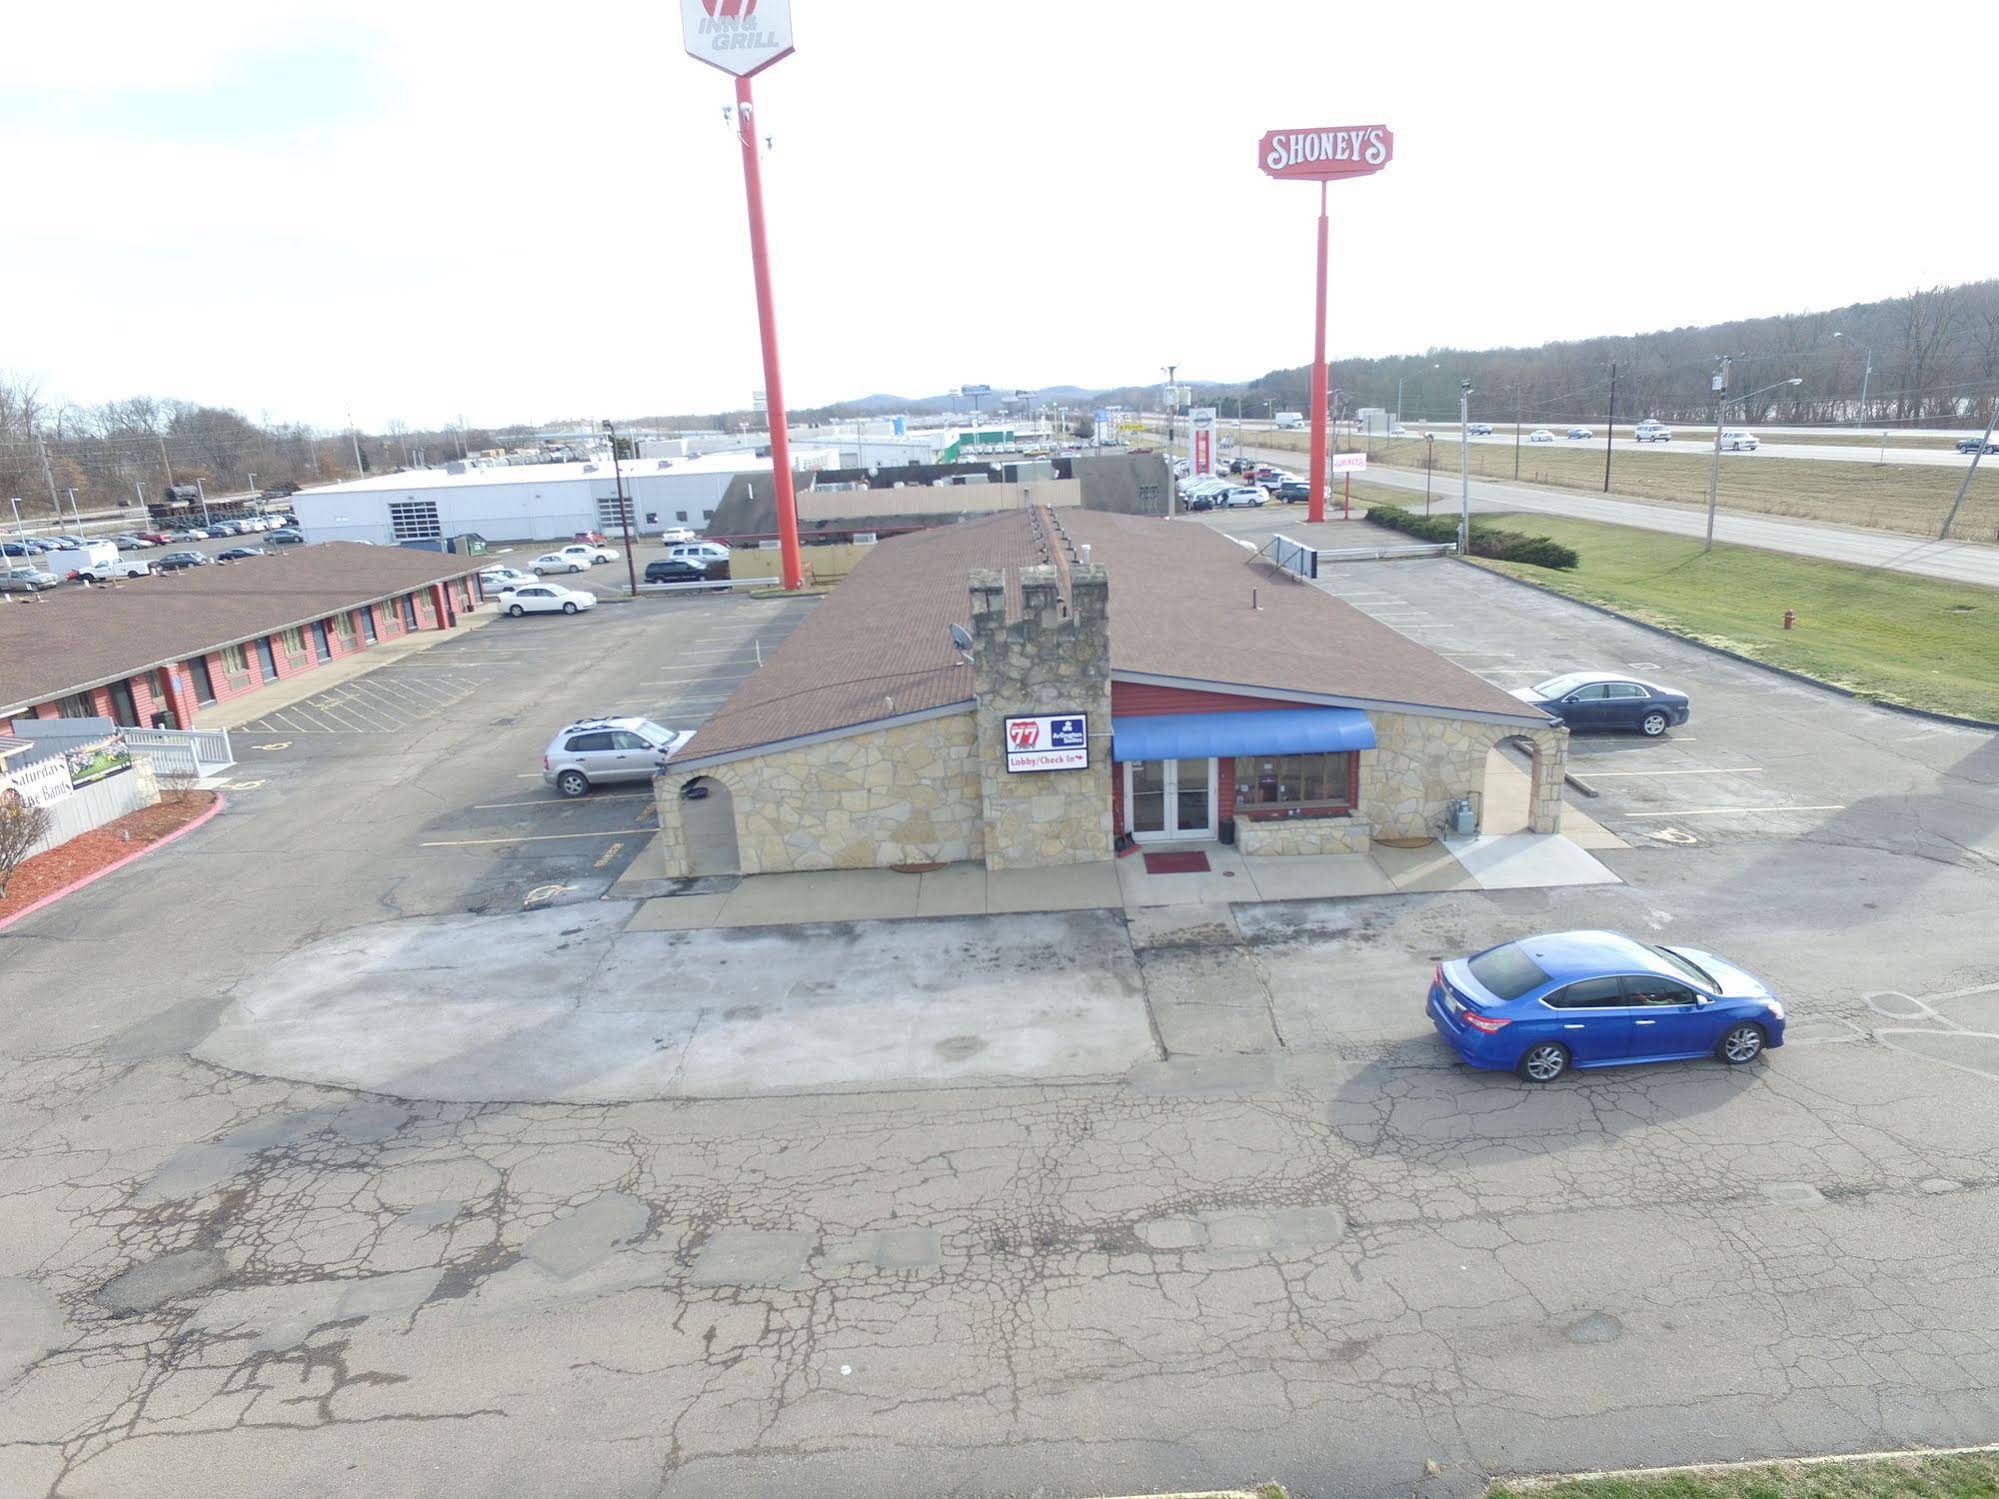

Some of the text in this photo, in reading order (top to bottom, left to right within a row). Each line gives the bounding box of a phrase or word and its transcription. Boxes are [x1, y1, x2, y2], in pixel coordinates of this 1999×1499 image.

[711, 31, 779, 51] GRILL
[1266, 127, 1387, 170] SHONEY'S
[1011, 727, 1038, 745] 77
[12, 763, 65, 786] Saturdays
[42, 780, 71, 801] Bands
